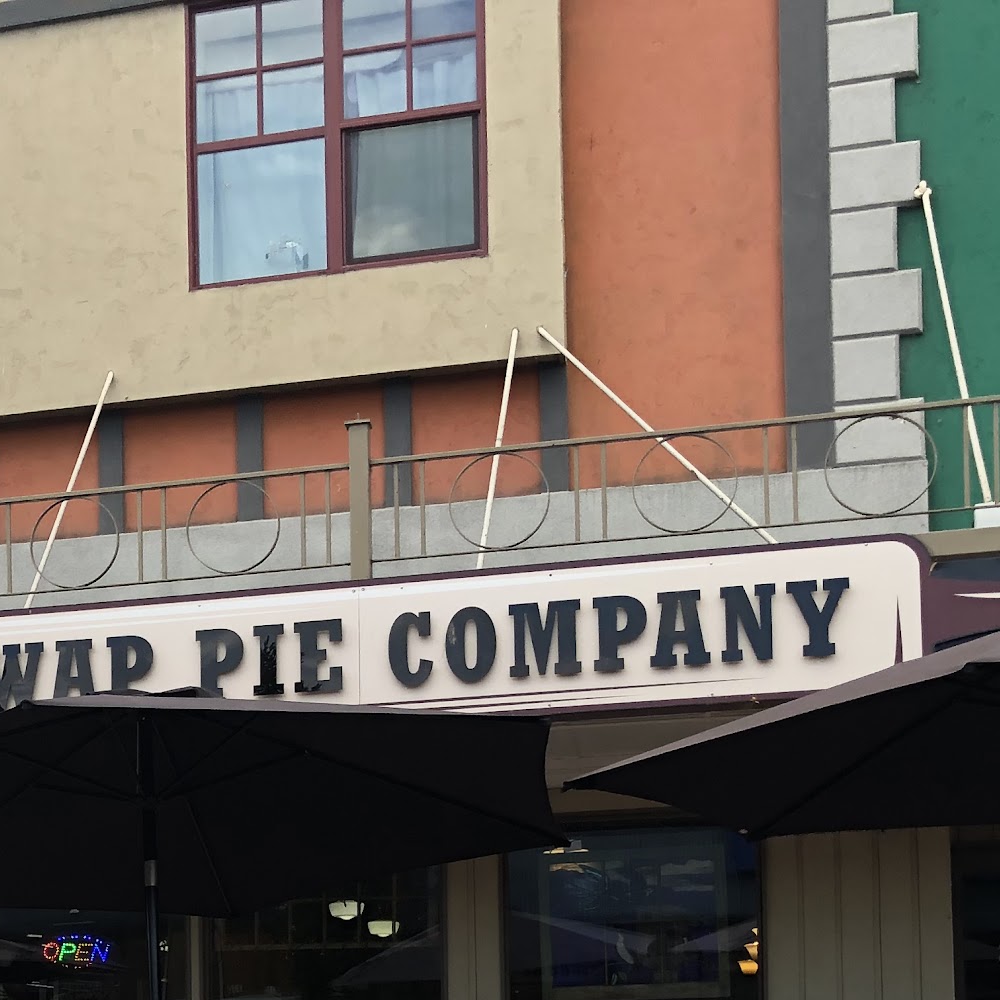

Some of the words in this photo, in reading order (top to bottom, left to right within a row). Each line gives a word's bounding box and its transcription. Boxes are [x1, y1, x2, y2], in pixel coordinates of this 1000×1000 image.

[195, 618, 344, 696] PIE
[388, 577, 850, 688] COMPANY
[43, 942, 110, 962] OPEN
